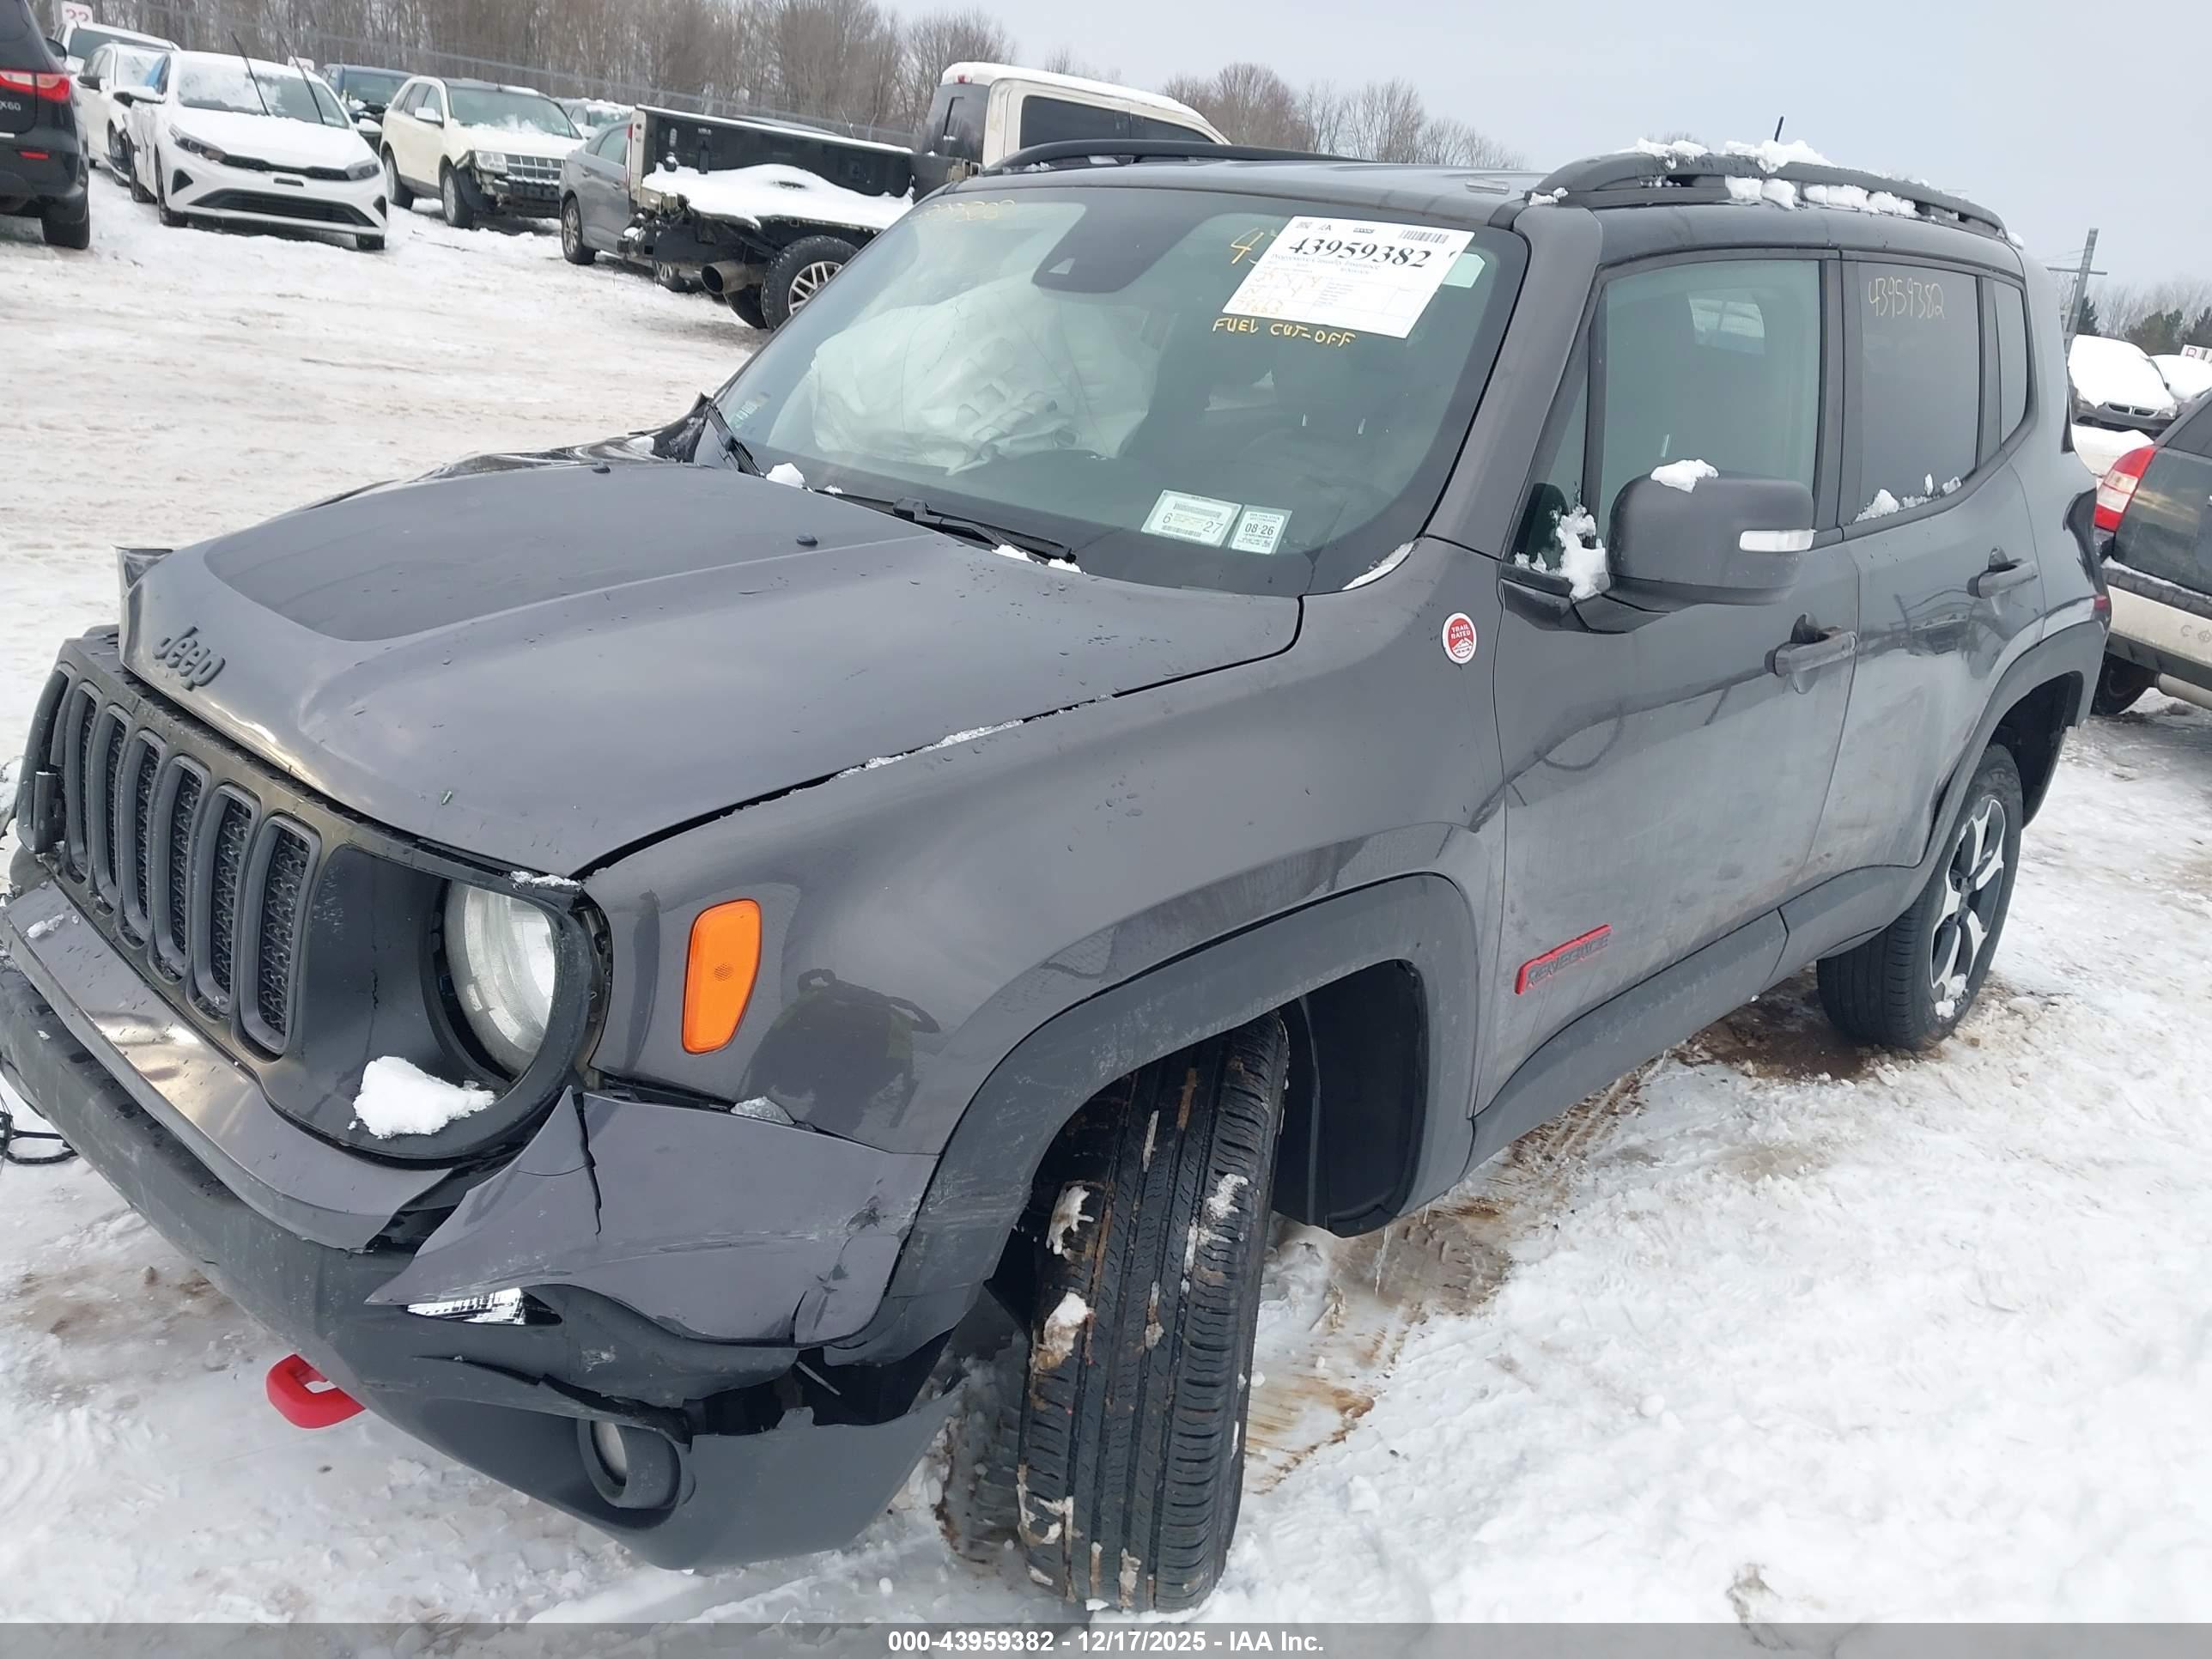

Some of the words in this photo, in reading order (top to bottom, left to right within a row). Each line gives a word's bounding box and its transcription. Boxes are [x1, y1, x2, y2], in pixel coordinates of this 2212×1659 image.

[1288, 237, 1432, 269] 43959382
[1868, 276, 1945, 319] 43959382
[1212, 317, 1259, 333] FUEL
[1270, 323, 1356, 347] CUT-OFF
[1163, 513, 1174, 525] 6
[1203, 520, 1224, 535] 27
[1451, 623, 1469, 633] TRAIL
[1451, 629, 1471, 640] RATED
[152, 626, 226, 692] Jeep
